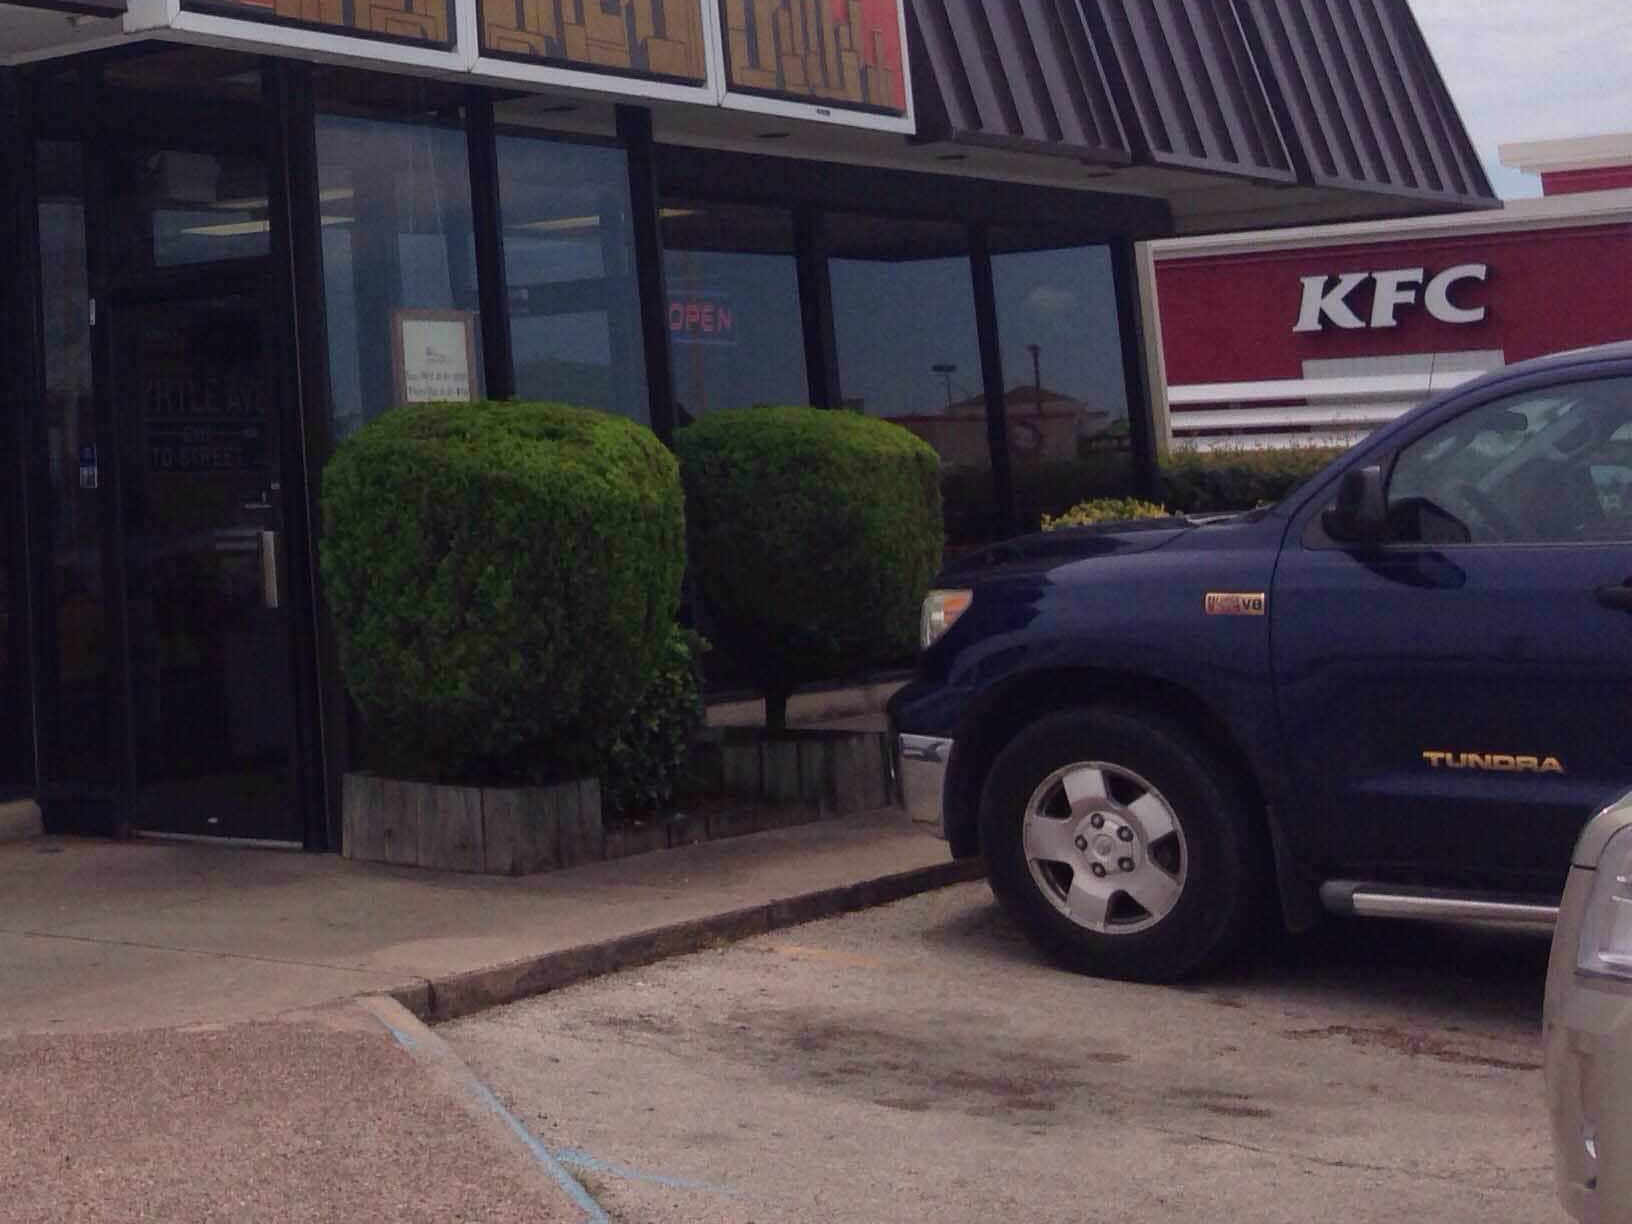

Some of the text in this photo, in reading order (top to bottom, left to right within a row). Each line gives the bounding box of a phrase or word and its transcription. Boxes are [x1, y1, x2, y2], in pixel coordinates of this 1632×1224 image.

[1293, 263, 1487, 333] KFC
[668, 302, 732, 332] OPEN
[1422, 750, 1565, 774] TUNDRA
